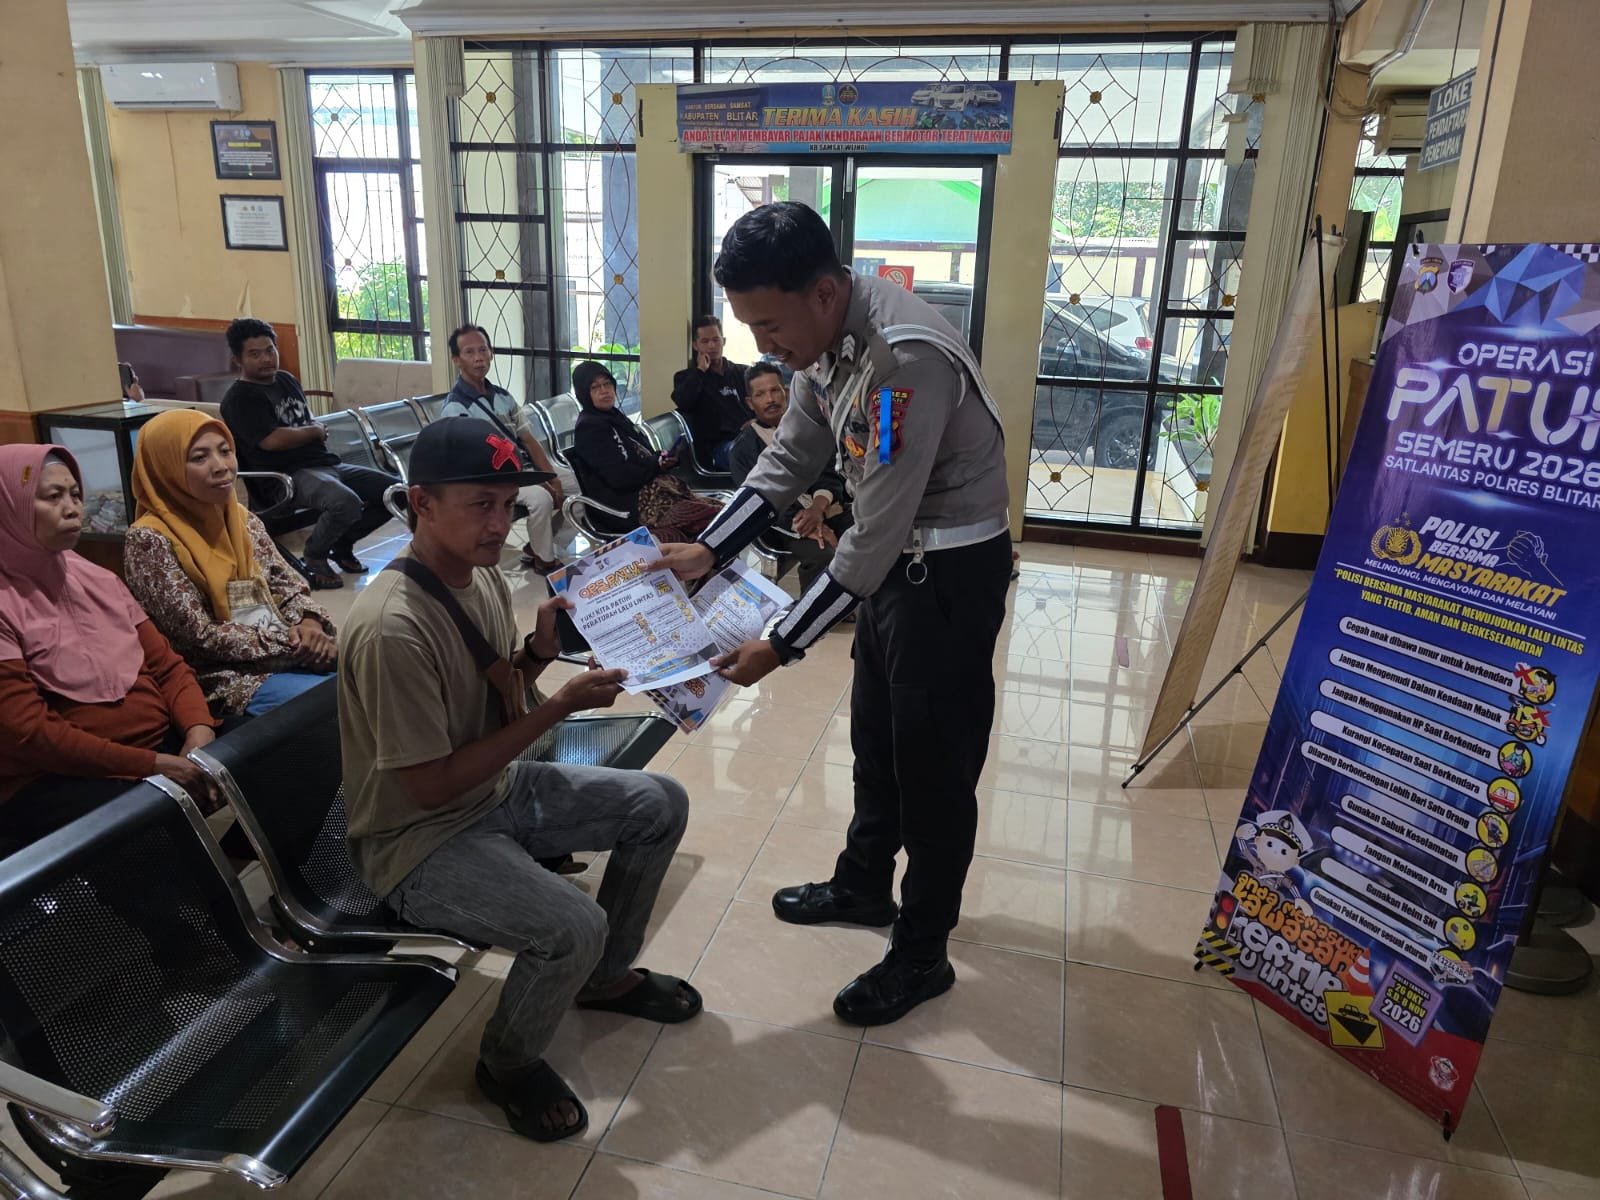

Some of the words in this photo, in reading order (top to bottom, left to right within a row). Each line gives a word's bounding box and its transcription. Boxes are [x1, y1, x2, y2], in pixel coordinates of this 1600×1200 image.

[684, 129, 707, 142] ANDA
[710, 129, 737, 142] TELAH
[739, 129, 791, 142] MEMBAYAR
[794, 131, 821, 142] PAJAK
[824, 131, 882, 142] KENDARAAN
[884, 131, 938, 142] BERMOTOR
[941, 130, 970, 142] TEPAT
[972, 130, 1011, 143] WAKTU
[726, 111, 759, 121] BLITAR
[762, 107, 843, 127] TERIMA
[847, 107, 918, 127] KASIH
[1458, 343, 1594, 376] OPERASI
[1395, 431, 1515, 470] SEMERU
[1384, 456, 1470, 482] SATLANTAS
[1473, 472, 1539, 495] POLRES
[1543, 484, 1600, 509] BLITAR
[1419, 515, 1500, 550] POLISI
[1428, 541, 1499, 568] BERSAMA
[1364, 558, 1421, 582] MELINDUNGI,
[1422, 574, 1481, 597] MENGAYOMI
[1481, 590, 1503, 604] DAN
[1505, 598, 1557, 620] MELAYANI
[1415, 553, 1567, 607] MASYARAKAT
[618, 604, 632, 614] LALU
[1360, 590, 1383, 603] YANG
[1415, 608, 1440, 624] AMAN
[1441, 616, 1460, 630] DAN
[1461, 622, 1543, 657] BERKESELAMATAN
[1364, 578, 1403, 596] BERSAMA
[1404, 588, 1460, 613] MASYARAKAT
[1463, 604, 1527, 635] MEWUJUDKAN
[1528, 625, 1551, 643] LALU
[1552, 634, 1584, 655] LINTAS
[1346, 622, 1369, 636] Cegah
[1370, 629, 1389, 643] anak
[1389, 634, 1417, 652] dibawa
[1418, 646, 1440, 660] umur
[1440, 654, 1463, 671] untuk
[1464, 662, 1513, 687] berkendara
[1339, 653, 1365, 671] Jangan
[1366, 662, 1411, 687] Mengemudi
[1411, 679, 1436, 697] Dalam
[1437, 690, 1472, 711] Keadaan
[1474, 701, 1502, 722] Mabuk
[1332, 686, 1358, 703] Jangan
[1358, 694, 1411, 725] Menggunakan
[1413, 714, 1424, 728] HP
[1424, 720, 1443, 737] Saat
[1443, 730, 1491, 758] Berkendara
[1342, 725, 1371, 744] Kurangi
[1372, 737, 1412, 764] Kecepatan
[1413, 754, 1431, 772] Saat
[1432, 764, 1480, 794] Berkendara
[1308, 746, 1336, 766] Dilarang
[1337, 758, 1389, 789] Berboncengan
[1390, 781, 1410, 798] Lebih
[1410, 792, 1426, 807] Dari
[1427, 800, 1445, 816] Satu
[1446, 809, 1470, 828] Orang
[1347, 802, 1380, 823] Gunakan
[1381, 815, 1405, 836] Sabuk
[1406, 826, 1458, 863] Keselamatan
[1364, 844, 1391, 865] Jangan
[1392, 858, 1428, 883] Melawan
[1428, 878, 1448, 896] Arus
[1314, 890, 1341, 911] Gunakan
[1359, 914, 1380, 935] Nomor
[1381, 929, 1404, 947] sesuai
[1405, 942, 1428, 963] aturan
[1366, 883, 1399, 905] Gunakan
[1400, 900, 1422, 920] Helm
[1423, 913, 1437, 929] SNI
[1382, 999, 1421, 1032] 2026
[1395, 983, 1405, 995] 26
[1406, 990, 1424, 1005] OKT
[1409, 1002, 1426, 1017] NOV
